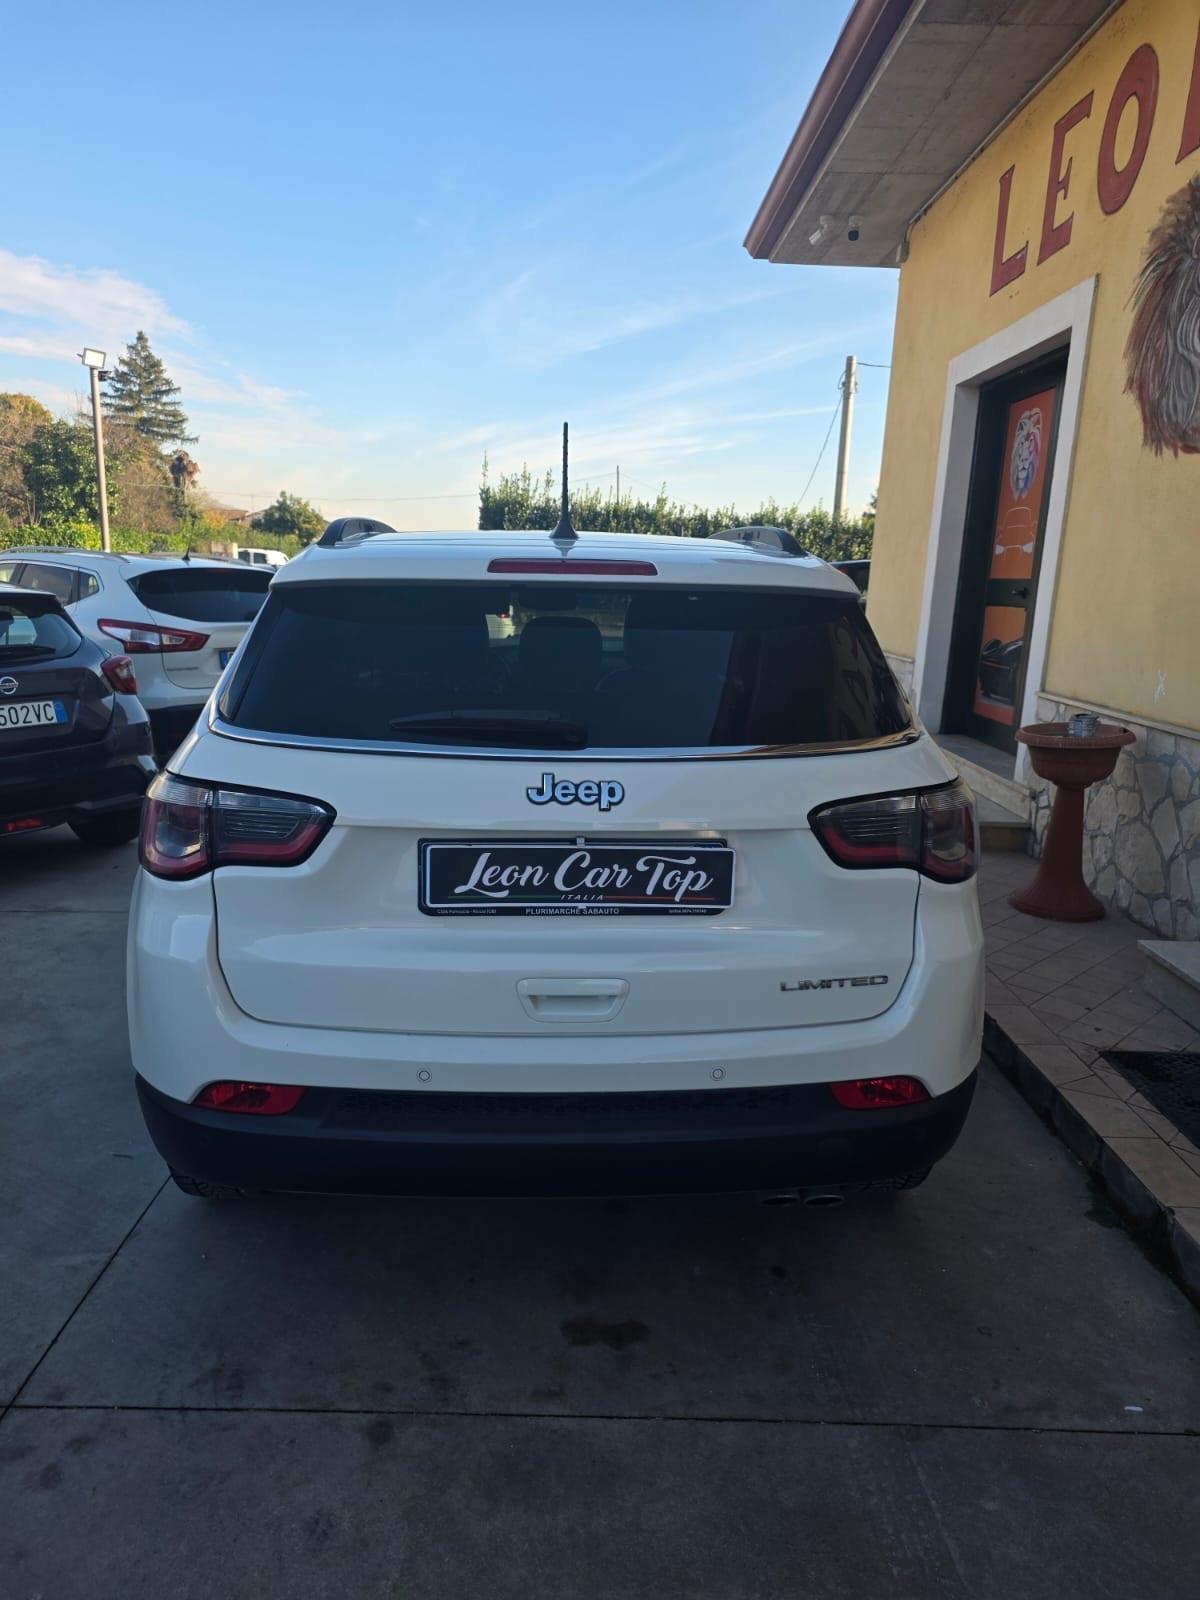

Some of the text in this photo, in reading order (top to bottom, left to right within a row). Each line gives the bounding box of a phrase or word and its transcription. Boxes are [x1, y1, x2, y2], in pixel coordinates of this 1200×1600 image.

[990, 19, 1200, 297] LEO
[526, 773, 624, 811] Jeep
[454, 851, 714, 902] Leon Car Top
[525, 907, 579, 915] PLURIMARCHE
[780, 975, 889, 992] LIMITED
